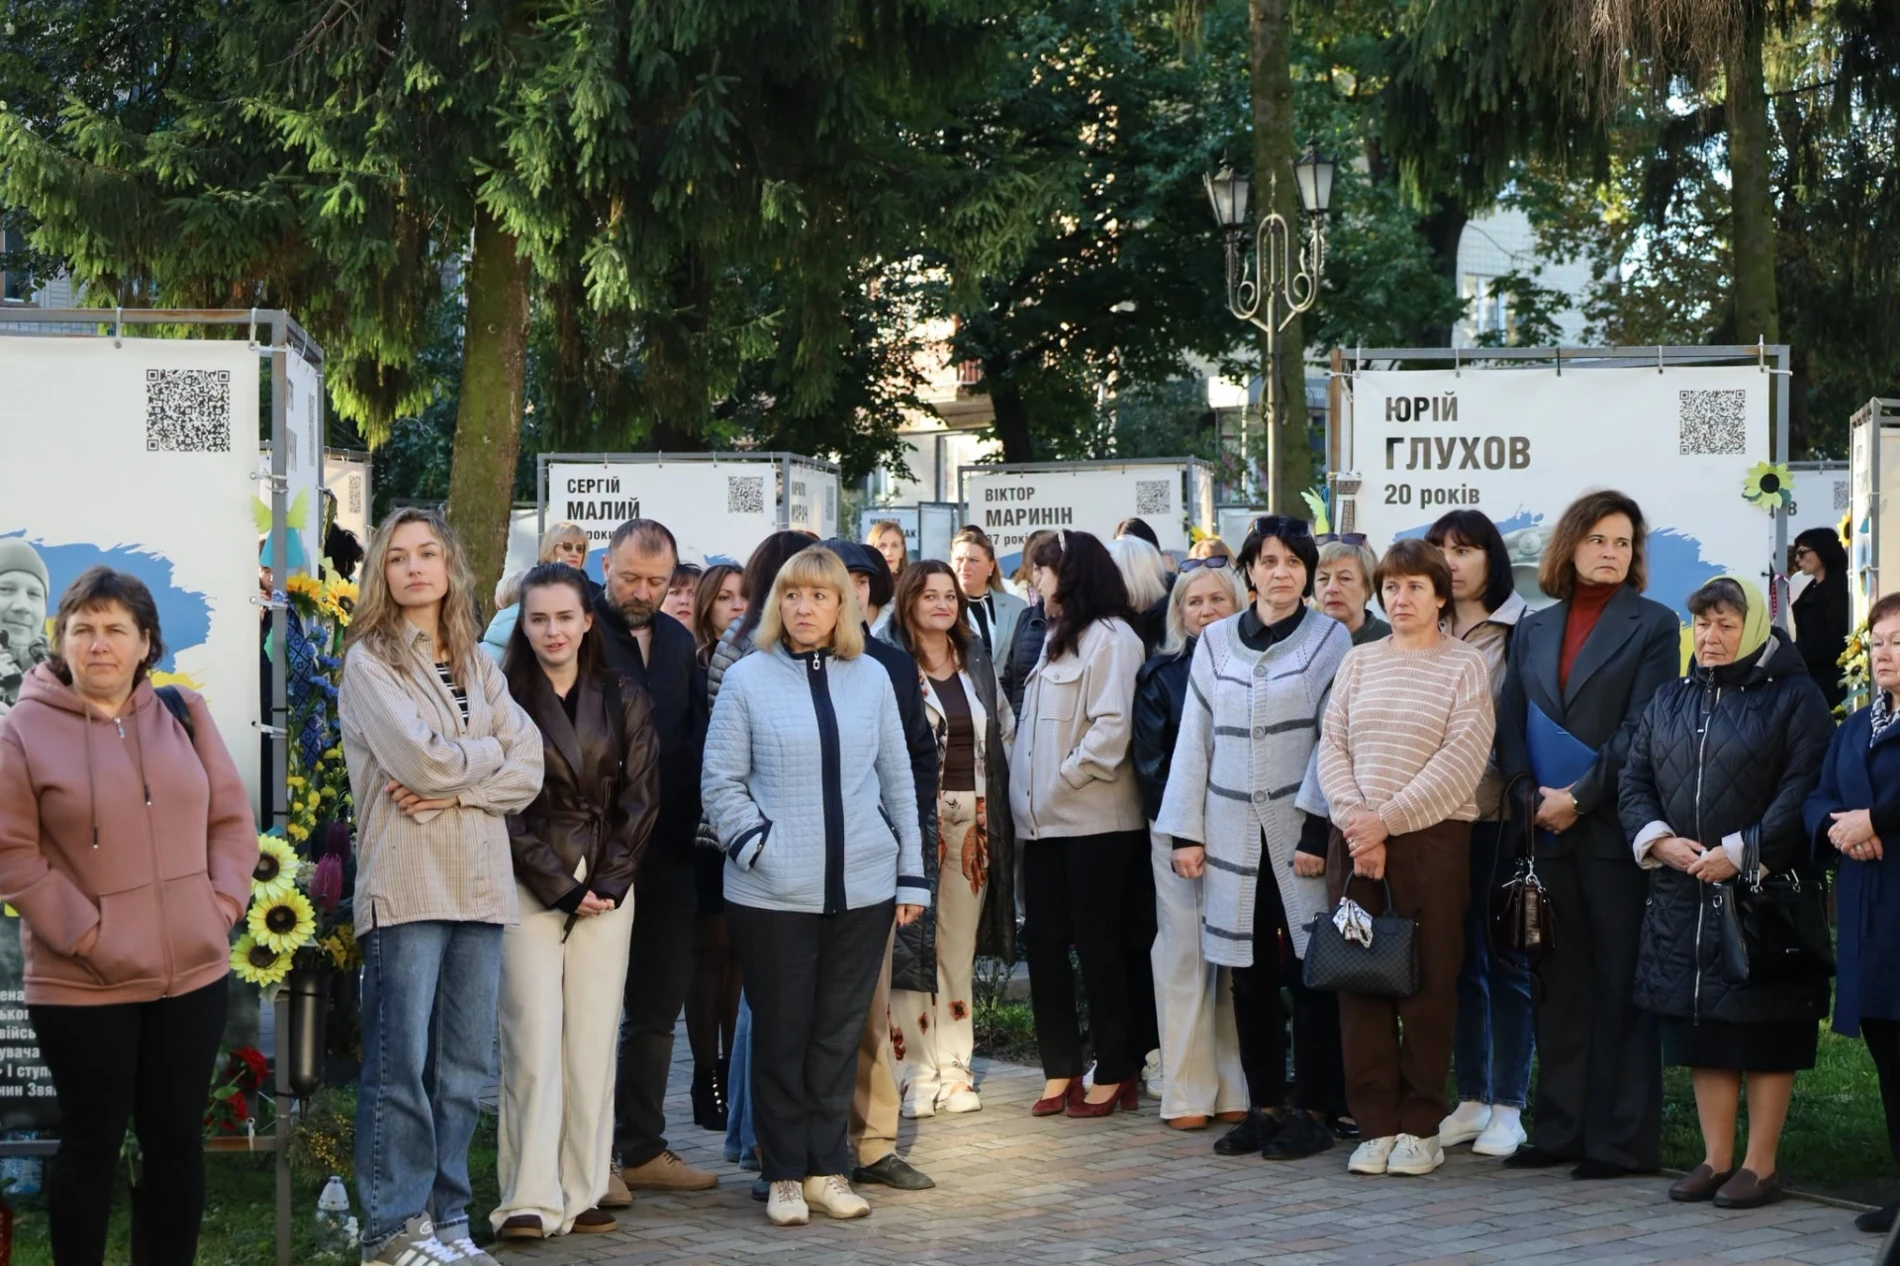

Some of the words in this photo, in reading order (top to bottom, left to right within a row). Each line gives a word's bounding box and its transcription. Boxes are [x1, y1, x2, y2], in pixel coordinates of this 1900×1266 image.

[1385, 391, 1458, 422] ЮРІЙ
[1385, 436, 1531, 470] ГЛУХОВ
[567, 476, 620, 494] СЕРГІЙ
[985, 486, 1035, 502] ВІКТОР
[1384, 483, 1412, 505] 20
[1420, 483, 1480, 509] років
[567, 496, 640, 520] МАЛИЙ
[985, 506, 1073, 527] МАРИНІН
